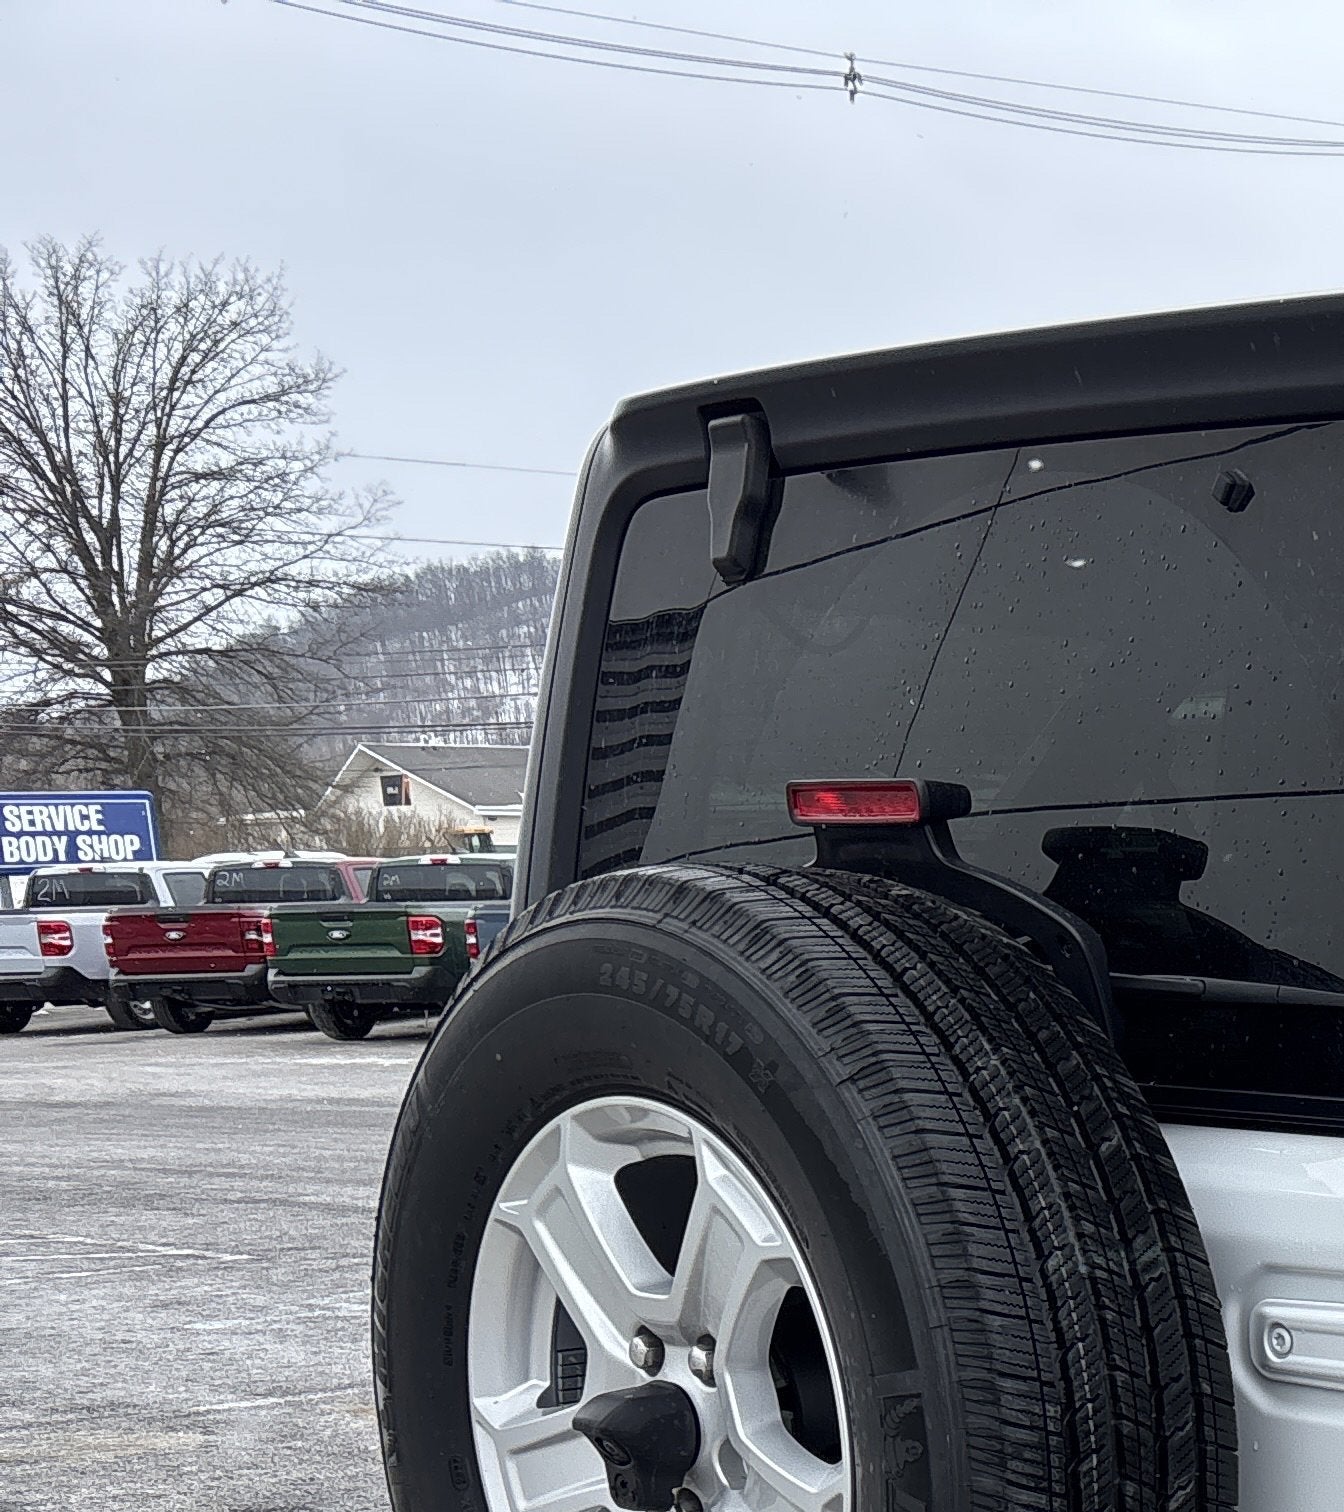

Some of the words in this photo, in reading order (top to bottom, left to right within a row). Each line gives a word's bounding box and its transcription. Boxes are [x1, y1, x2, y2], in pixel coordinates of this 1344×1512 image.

[2, 804, 106, 832] SERVICE
[1, 835, 68, 863] BODY
[76, 834, 141, 861] SHOP
[598, 962, 744, 1056] 245/75R17
